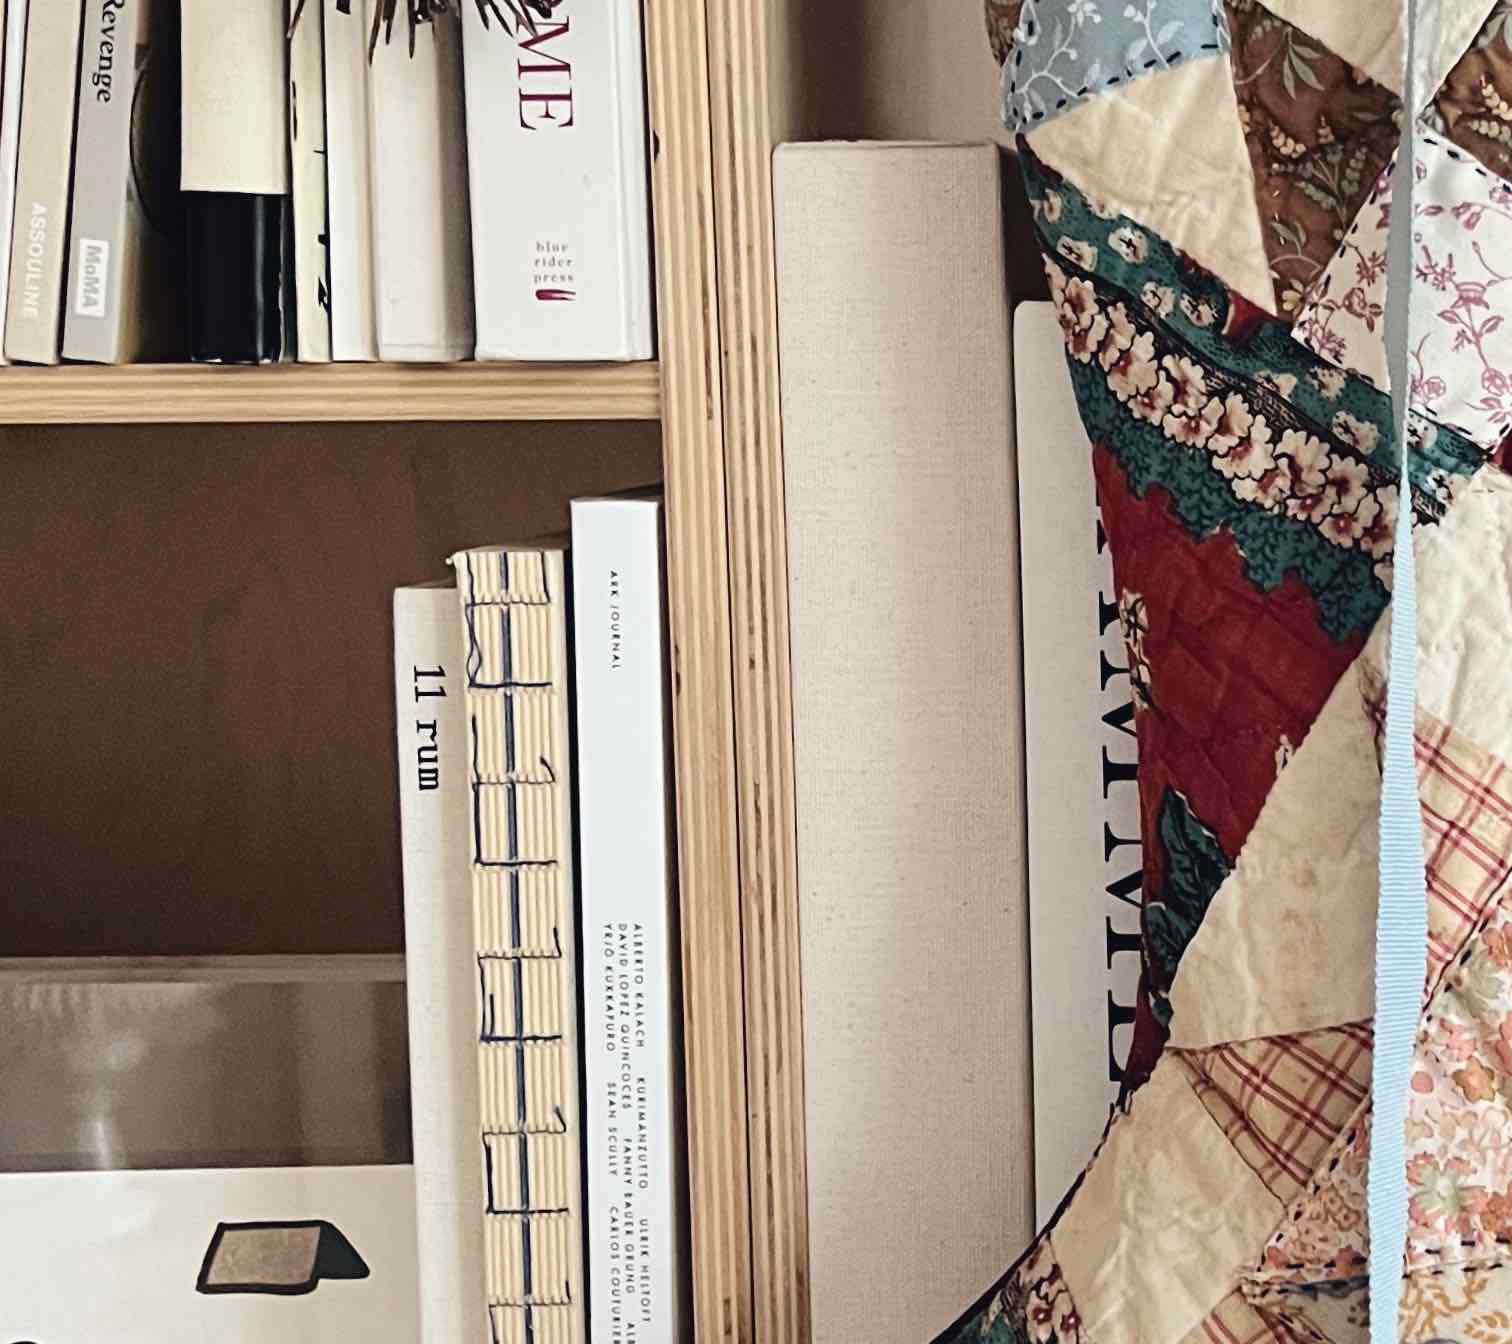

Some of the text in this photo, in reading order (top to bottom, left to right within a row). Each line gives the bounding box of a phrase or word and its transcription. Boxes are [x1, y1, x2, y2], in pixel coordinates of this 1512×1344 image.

[23, 201, 49, 319] ASSOULINE
[534, 255, 573, 268] rider
[535, 240, 568, 253] blue
[81, 245, 102, 309] MoMA
[533, 273, 574, 285] press
[610, 570, 622, 673] ARK JOURNAL
[416, 719, 440, 792] rum
[618, 923, 629, 967] DAVID
[633, 923, 645, 985] ALBERTO
[635, 993, 646, 1048] KALACH
